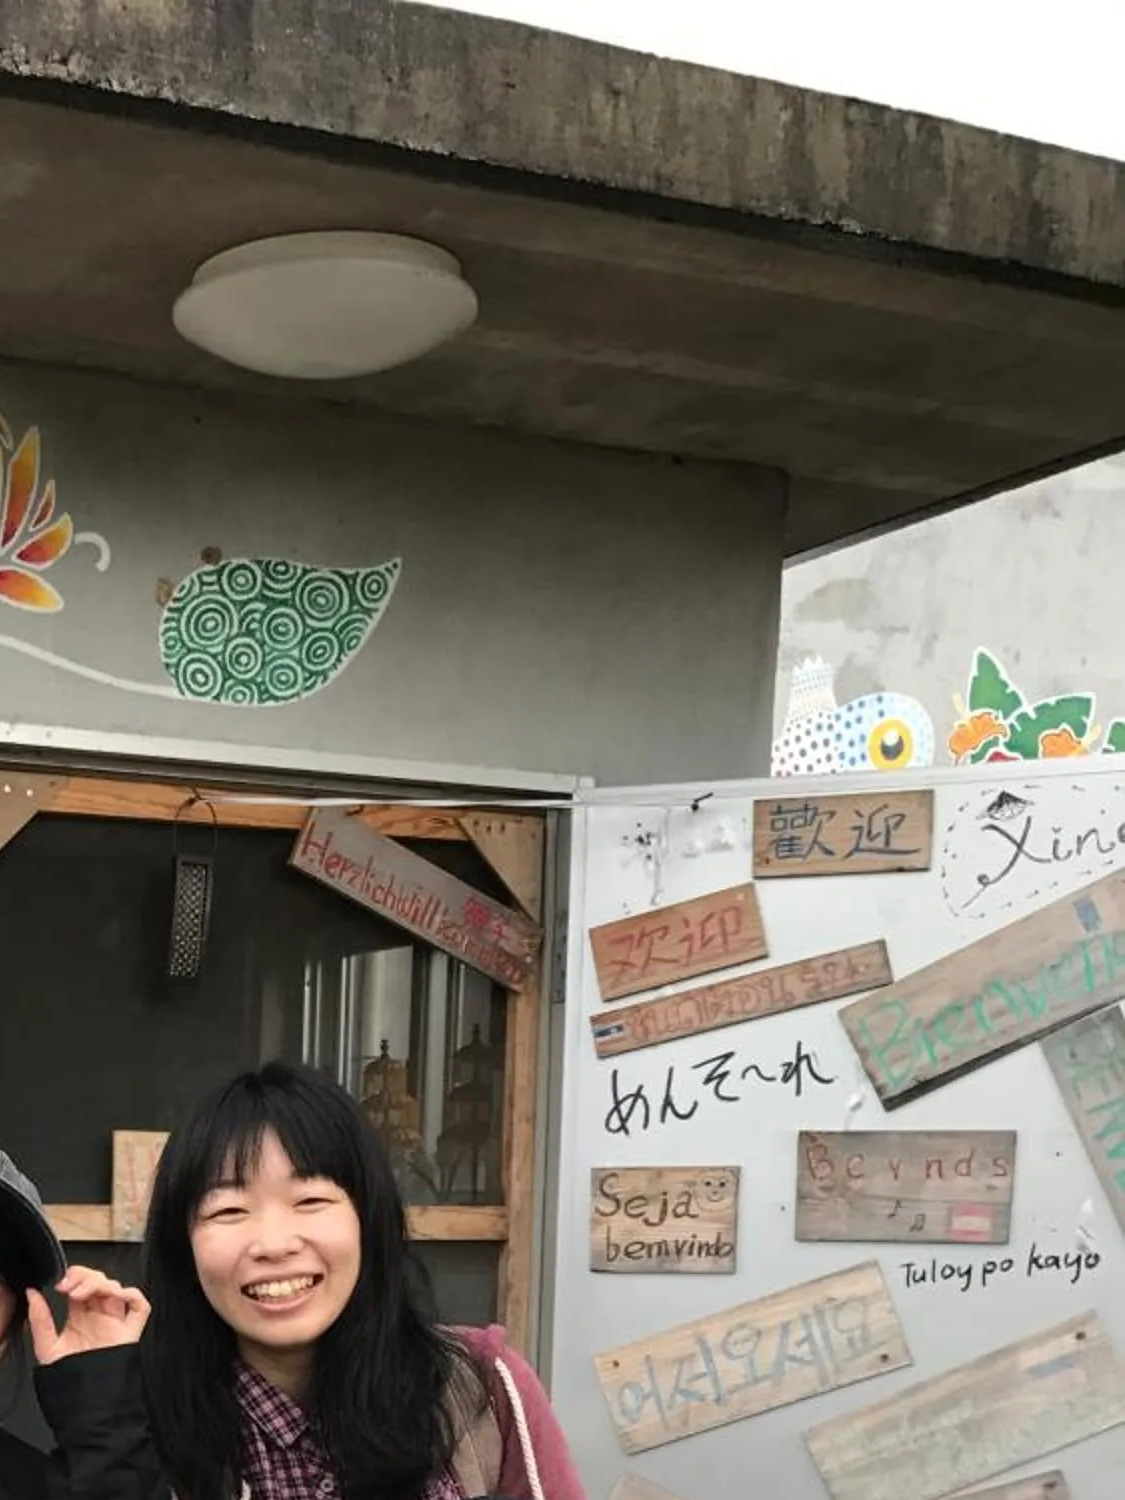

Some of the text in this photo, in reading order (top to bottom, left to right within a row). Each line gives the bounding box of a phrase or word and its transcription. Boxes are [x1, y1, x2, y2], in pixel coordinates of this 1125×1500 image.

[769, 803, 922, 861] 歡迎
[607, 906, 742, 980] 欢迎
[595, 1172, 699, 1227] Seja
[900, 1242, 1101, 1292] Tuloy po kayo
